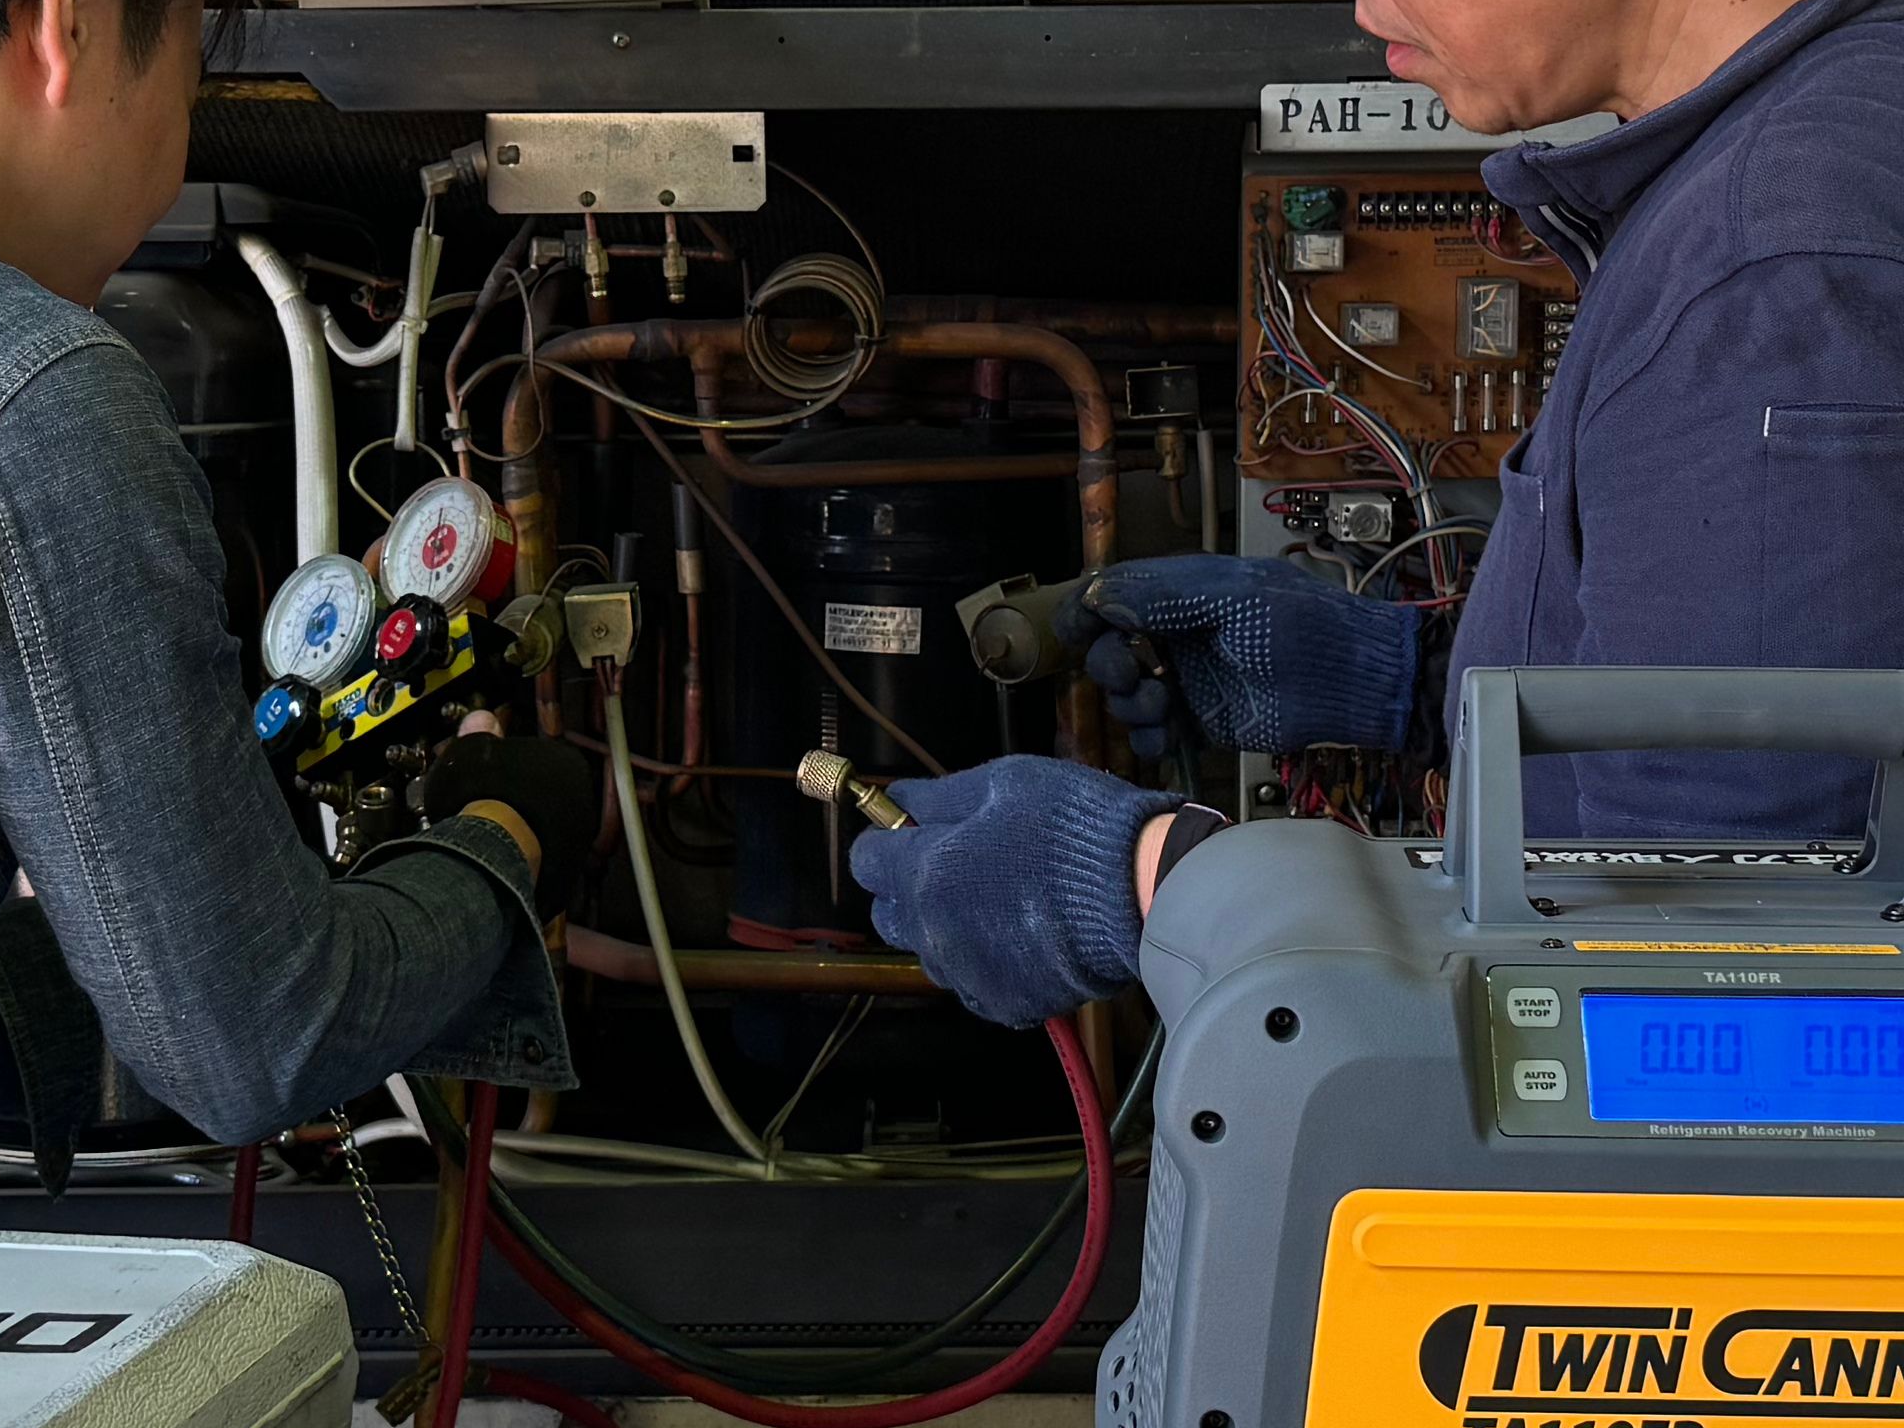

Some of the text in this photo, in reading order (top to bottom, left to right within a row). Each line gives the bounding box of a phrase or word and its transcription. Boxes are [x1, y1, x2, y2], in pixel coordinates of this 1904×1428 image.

[1703, 971, 1782, 984] TA110FR
[1513, 999, 1554, 1008] START
[1518, 1009, 1551, 1018] STOP
[1523, 1071, 1557, 1080] AUTO
[1525, 1081, 1557, 1091] STOP
[1649, 1124, 1877, 1139] Refrigerant Recovery Machine
[1477, 1304, 1693, 1395] TWIN
